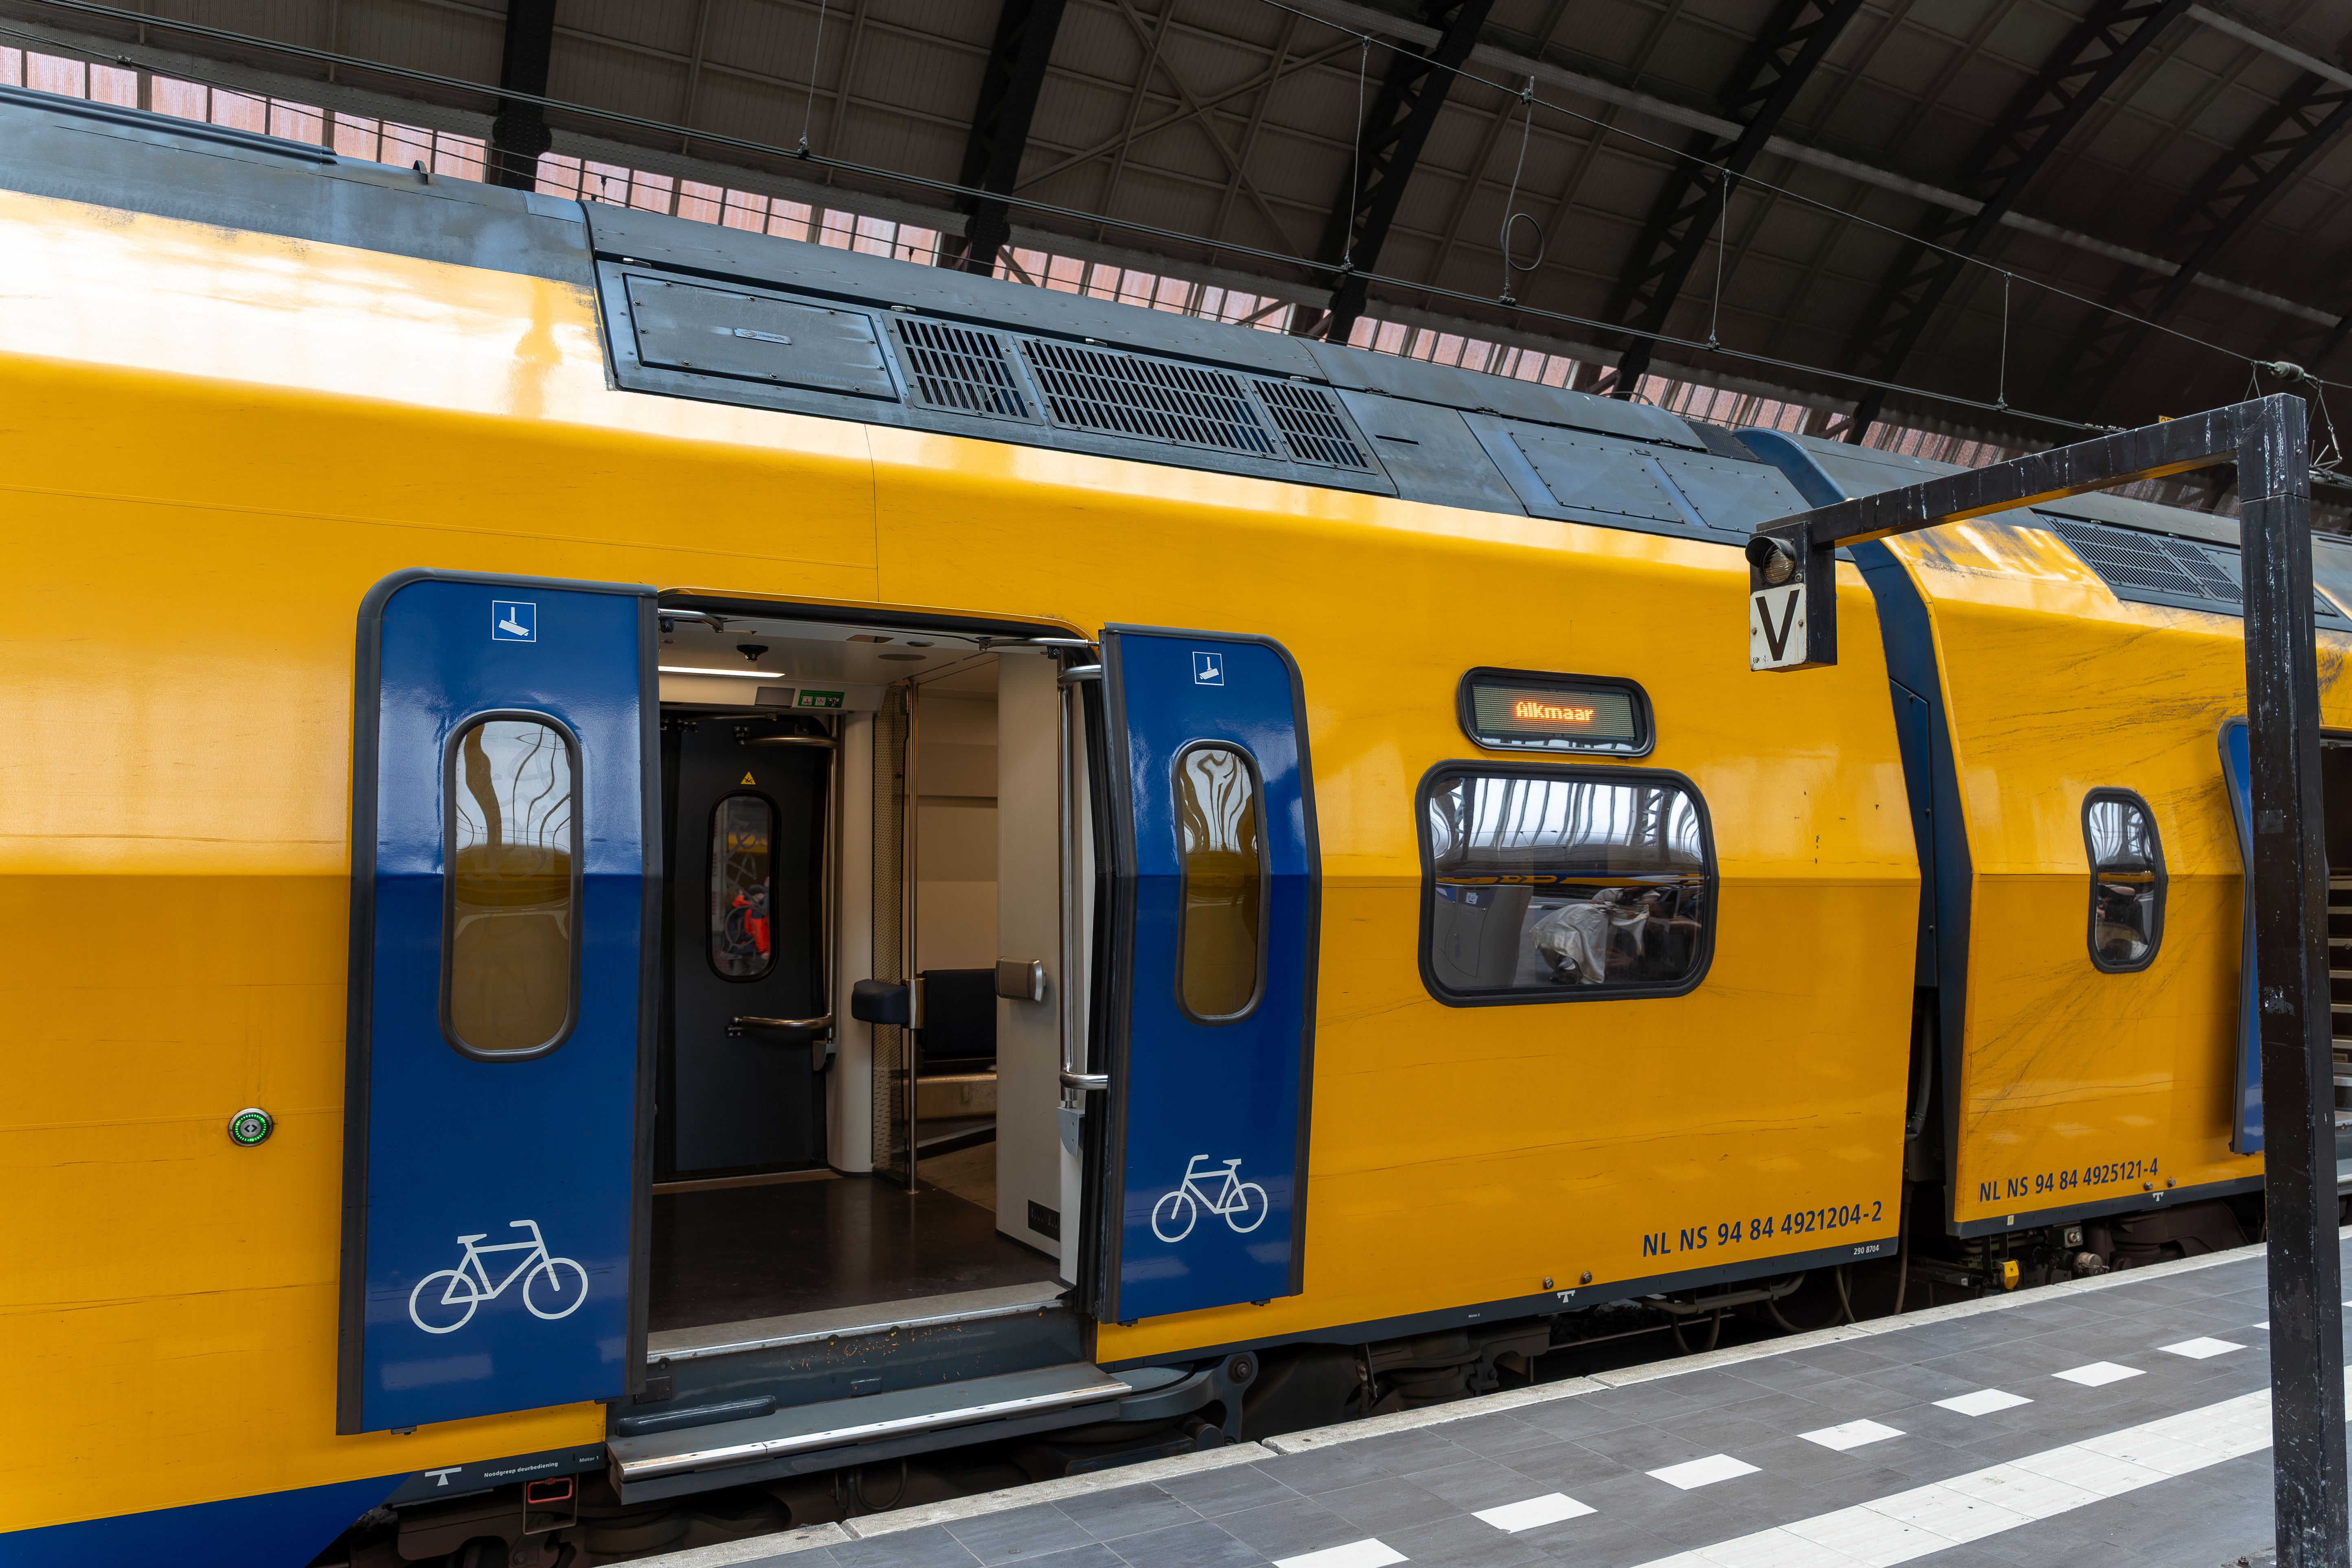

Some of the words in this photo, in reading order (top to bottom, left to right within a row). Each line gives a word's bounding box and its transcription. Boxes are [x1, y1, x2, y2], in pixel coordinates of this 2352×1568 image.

[1755, 589, 1800, 662] V
[1516, 702, 1594, 721] Alkmaar
[1980, 1181, 2001, 1202] NL
[2007, 1177, 2028, 1198] NS
[2035, 1173, 2054, 1194] 94
[2060, 1169, 2078, 1190] 84
[2083, 1158, 2158, 1186] 4925121-4
[1643, 1232, 1671, 1257] NL
[1680, 1226, 1707, 1251] NS
[1718, 1221, 1742, 1246] 94
[1750, 1219, 1774, 1240] 84
[1781, 1201, 1882, 1235] 4921204-2
[1854, 1247, 1865, 1255] 290
[1866, 1244, 1879, 1253] 8704
[484, 1469, 516, 1478] Noodgreep
[517, 1462, 558, 1472] deurbediening
